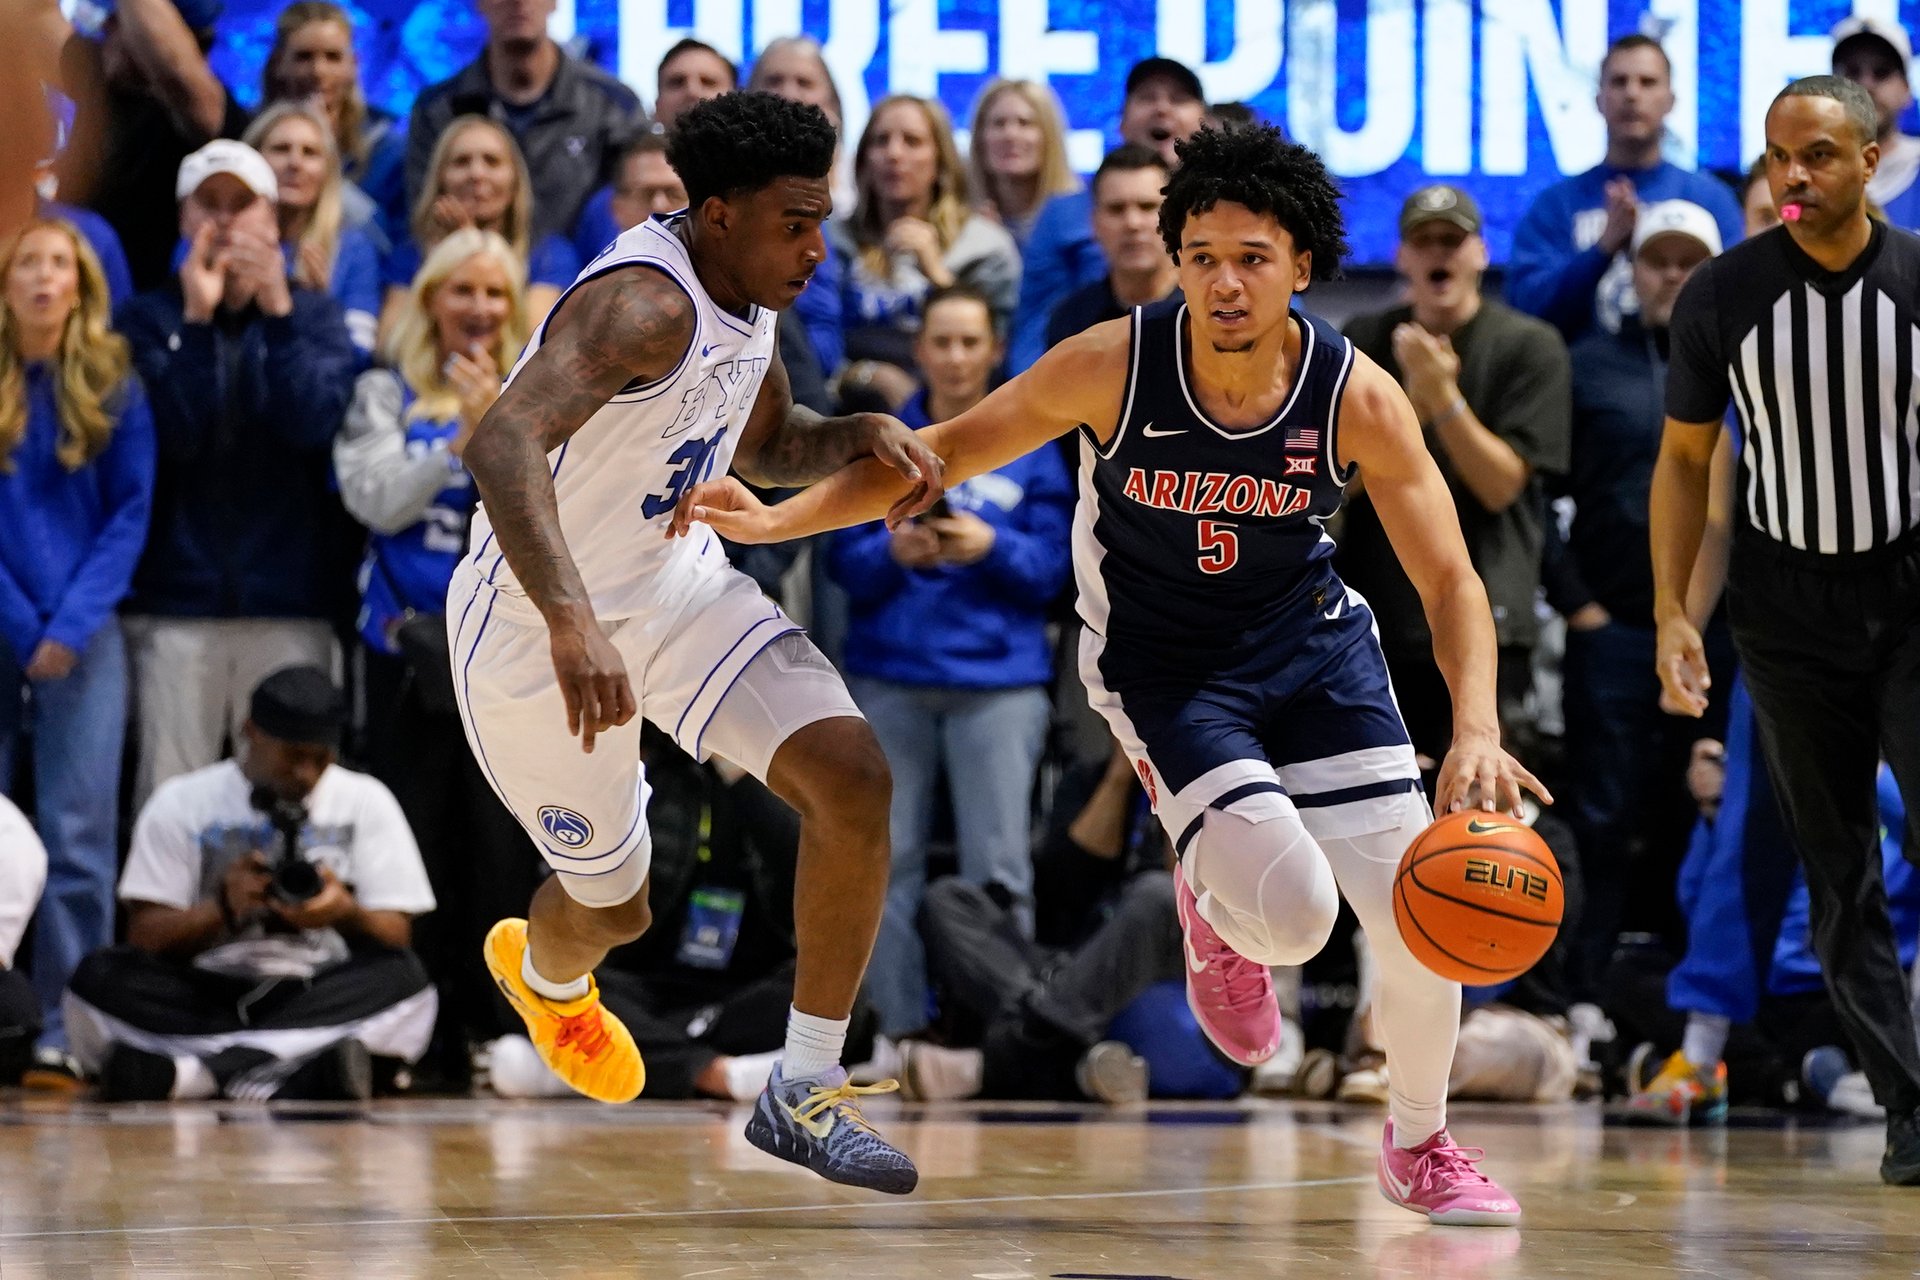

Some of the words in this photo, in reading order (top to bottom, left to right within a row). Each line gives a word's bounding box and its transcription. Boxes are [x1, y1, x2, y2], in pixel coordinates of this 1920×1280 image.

[546, 0, 1099, 176] HREE
[1284, 456, 1317, 475] XII
[1123, 467, 1311, 516] ARIZONA
[1197, 520, 1239, 575] 5
[1465, 858, 1548, 902] ELITE
